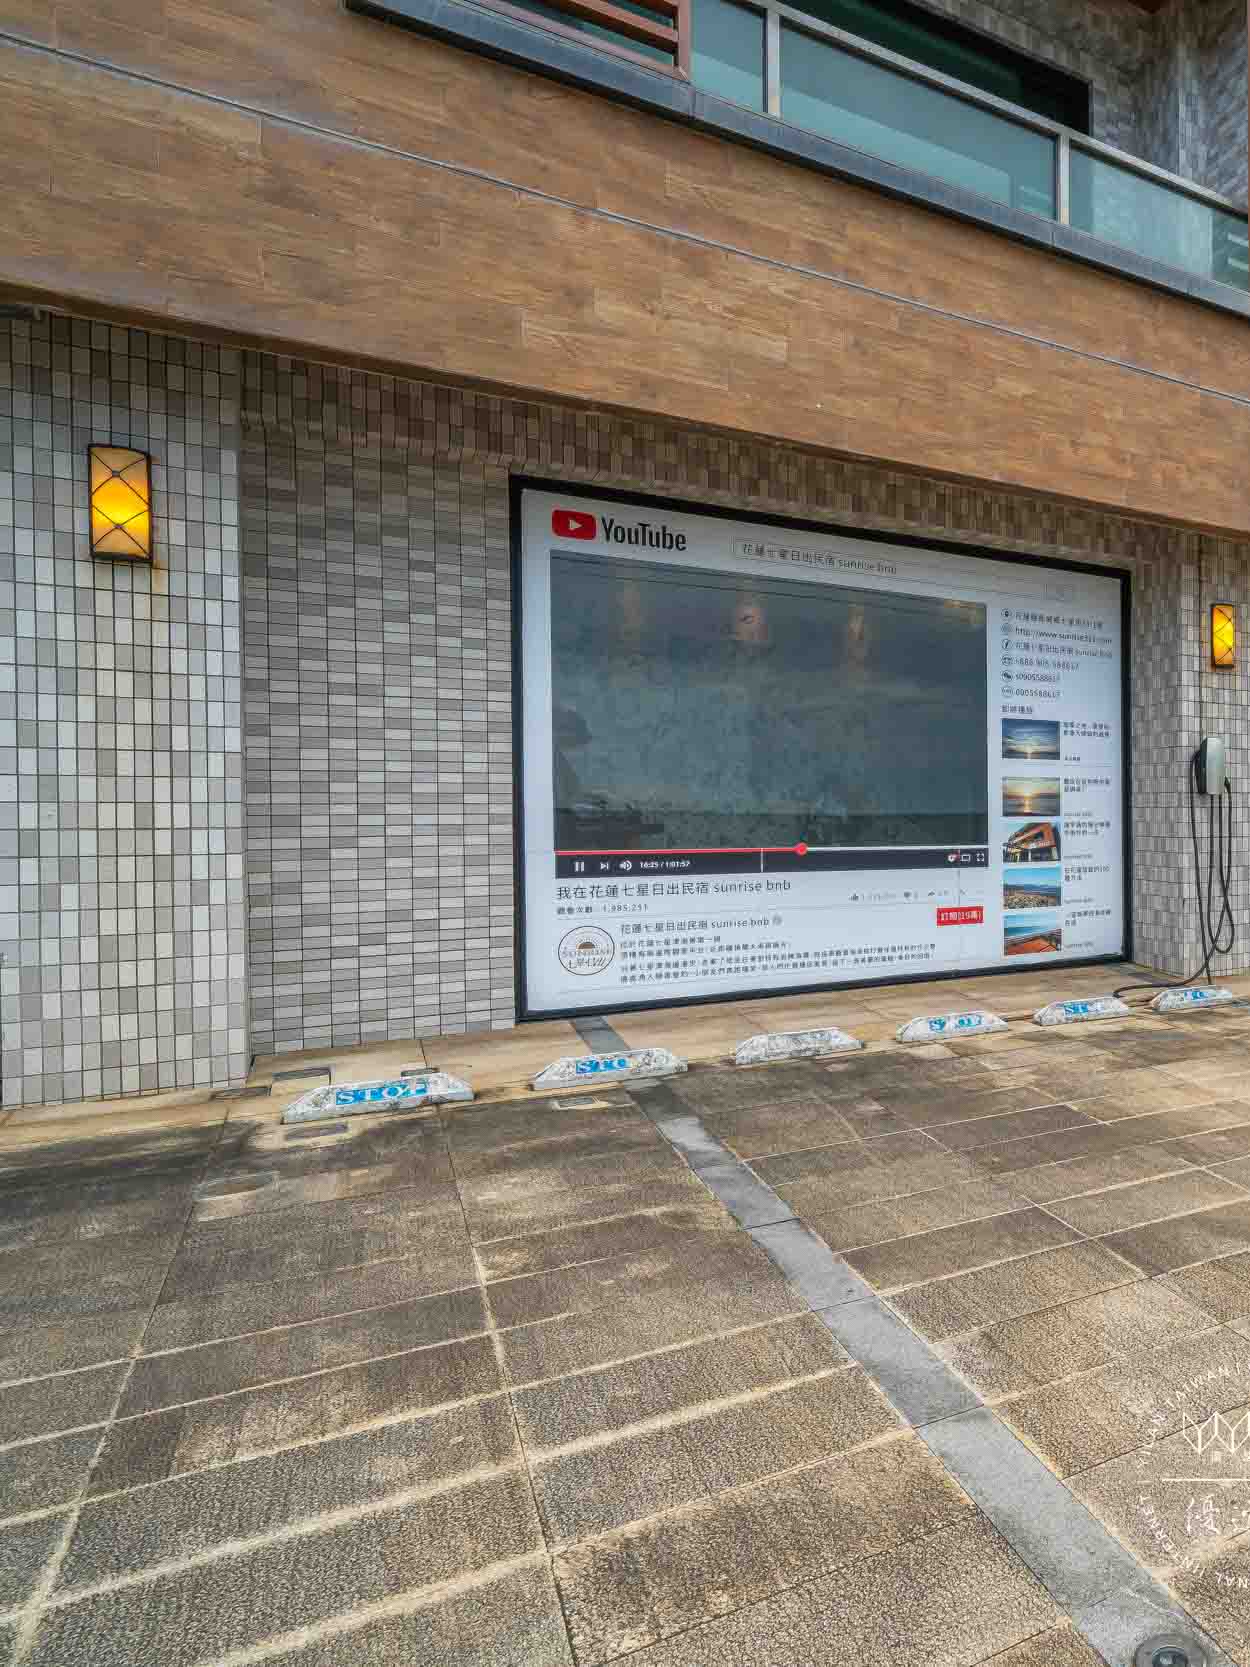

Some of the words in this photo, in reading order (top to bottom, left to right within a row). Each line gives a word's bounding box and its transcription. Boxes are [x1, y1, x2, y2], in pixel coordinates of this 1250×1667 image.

[601, 517, 687, 551] YouTube
[557, 881, 709, 900] 我在花蓮七星日出民宿
[713, 880, 762, 893] sunrise
[766, 879, 792, 892] bnb
[711, 919, 748, 930] sunrise
[750, 917, 770, 927] bnb
